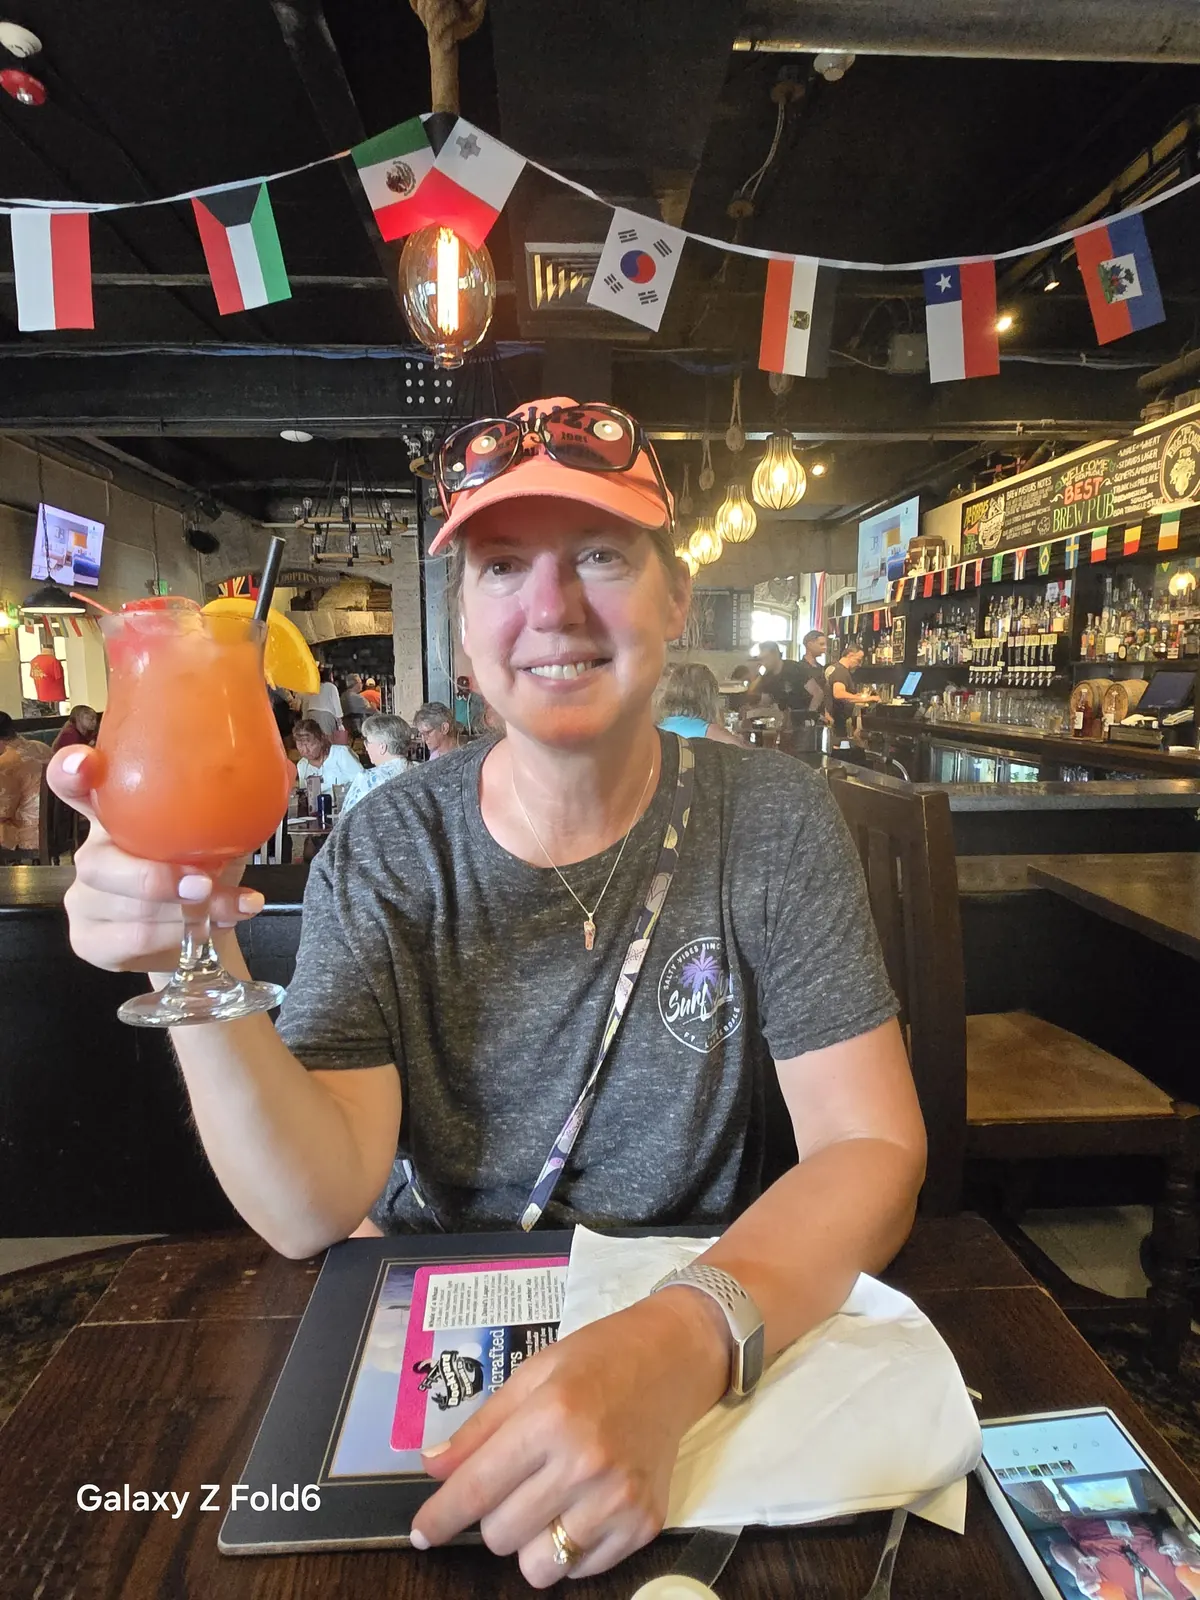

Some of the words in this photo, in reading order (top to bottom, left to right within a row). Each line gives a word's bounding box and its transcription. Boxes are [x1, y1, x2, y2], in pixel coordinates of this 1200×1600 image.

[1061, 459, 1109, 485] WELCOME
[1179, 446, 1192, 459] PUB
[1064, 476, 1104, 506] BEST
[1052, 501, 1086, 533] BREW
[1087, 492, 1114, 523] PUB
[663, 963, 677, 990] SALTY
[701, 943, 722, 951] SINC
[665, 983, 709, 1023] Surf
[441, 1353, 460, 1406] Dockyard
[488, 1328, 505, 1393] dcrafted
